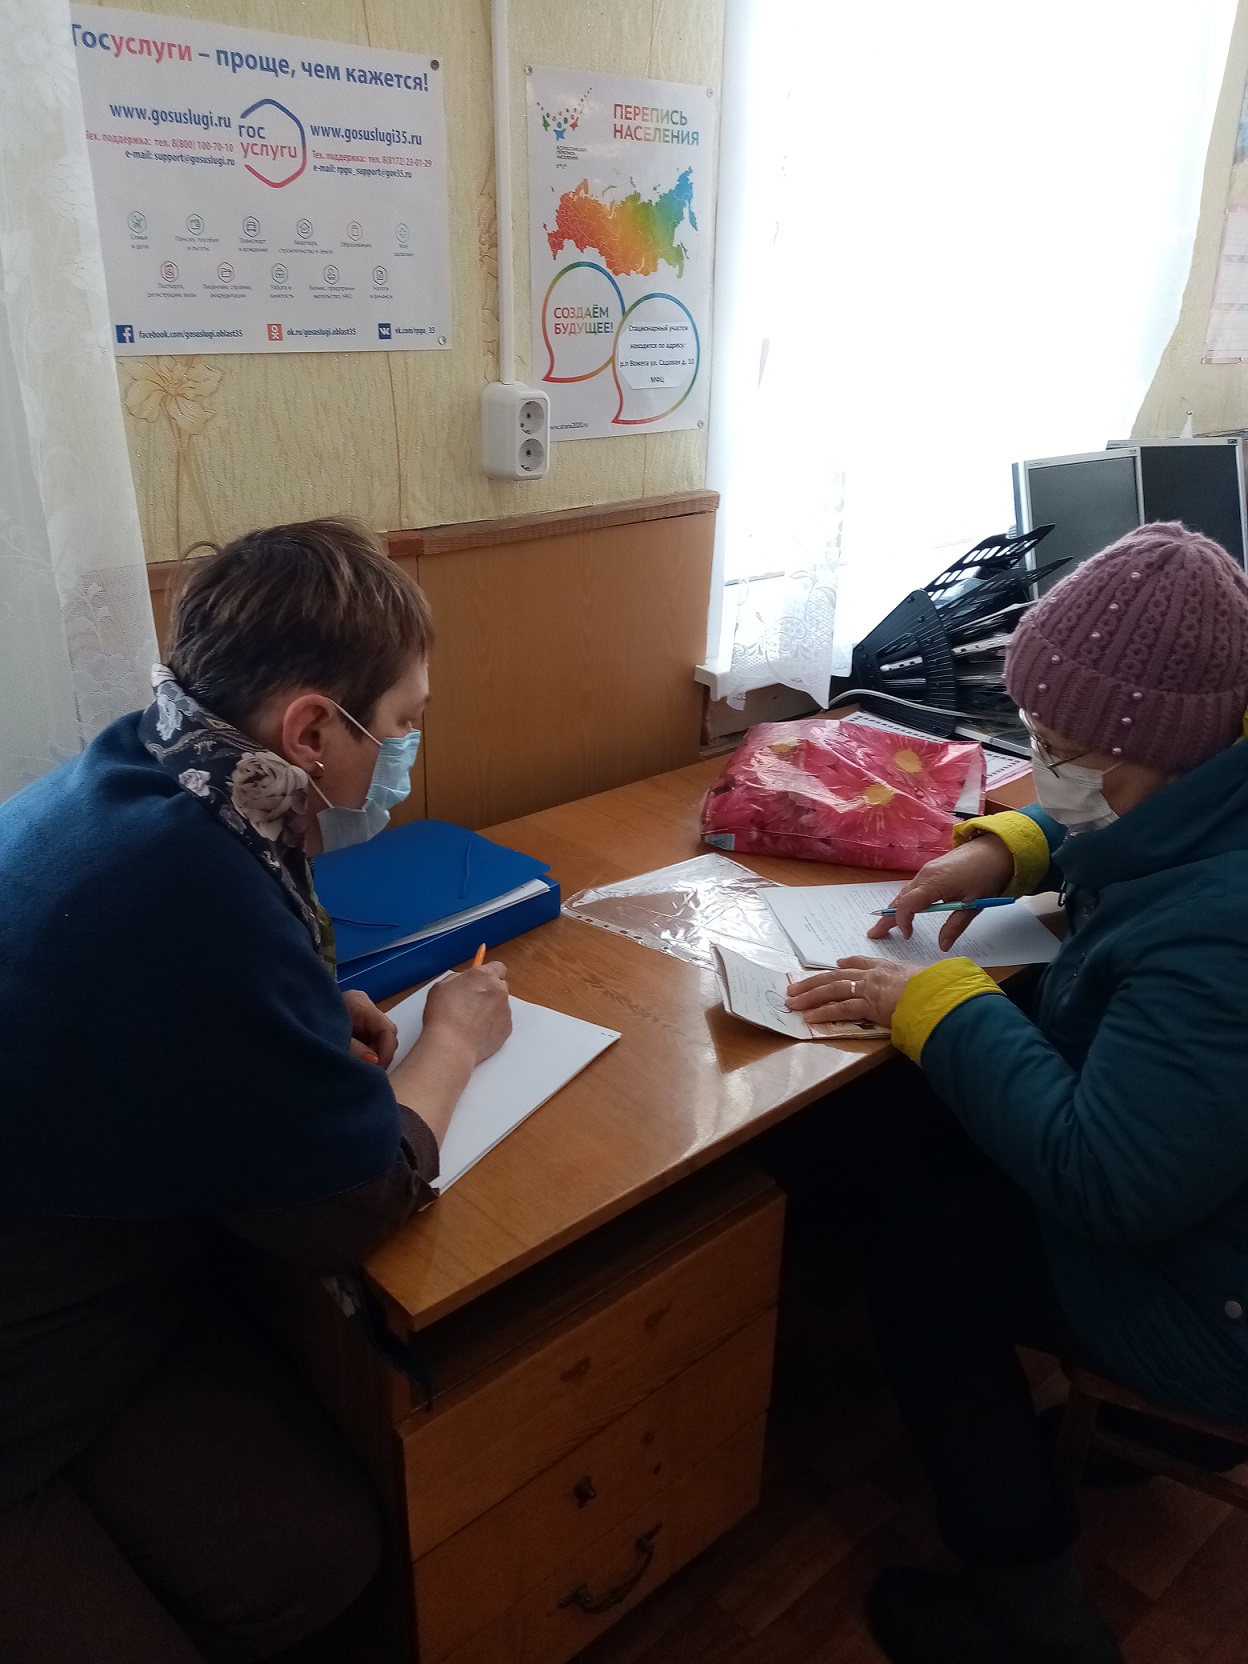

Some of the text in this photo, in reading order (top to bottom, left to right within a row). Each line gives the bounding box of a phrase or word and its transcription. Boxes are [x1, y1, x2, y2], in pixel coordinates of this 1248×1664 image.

[71, 23, 193, 64] Госуслуги
[215, 49, 296, 78] проще,
[301, 60, 341, 81] чем
[346, 66, 429, 92] кажется!
[109, 104, 232, 130] www.gosuslugi.ru
[613, 103, 688, 126] ПЕРЕПИСЬ
[238, 124, 267, 139] гос
[310, 124, 423, 146] www.gosuslugi35.ru
[613, 123, 700, 146] НАСЕЛЕНИЯ
[240, 141, 298, 161] услуги
[553, 304, 609, 320] СОЗДАЁМ
[554, 322, 614, 336] БУДУЩЕЕ!
